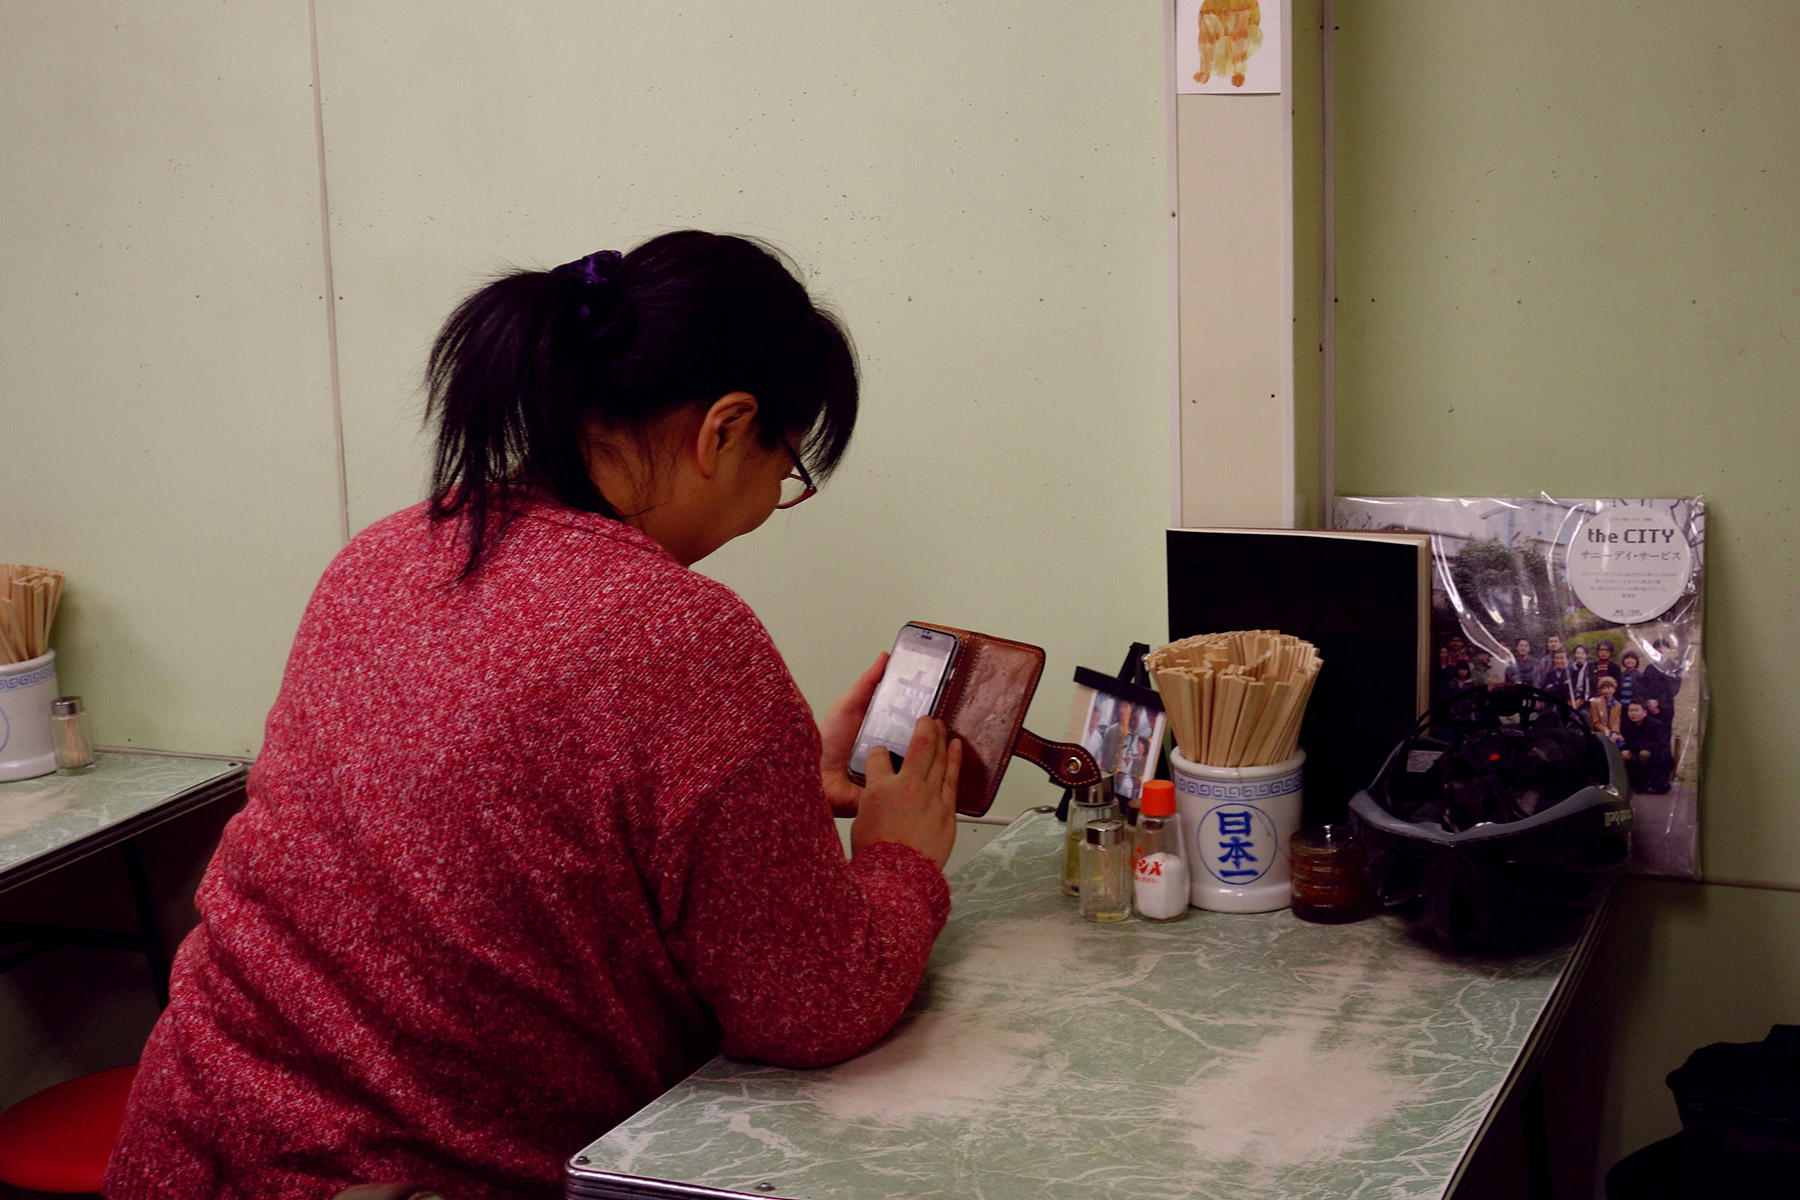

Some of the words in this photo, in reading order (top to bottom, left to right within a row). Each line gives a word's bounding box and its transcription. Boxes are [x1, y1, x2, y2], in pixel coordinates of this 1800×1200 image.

[1588, 529, 1618, 543] the
[1624, 529, 1674, 543] CITY
[1581, 550, 1681, 561] サニーデイ・サービス
[1216, 811, 1258, 877] 日本一
